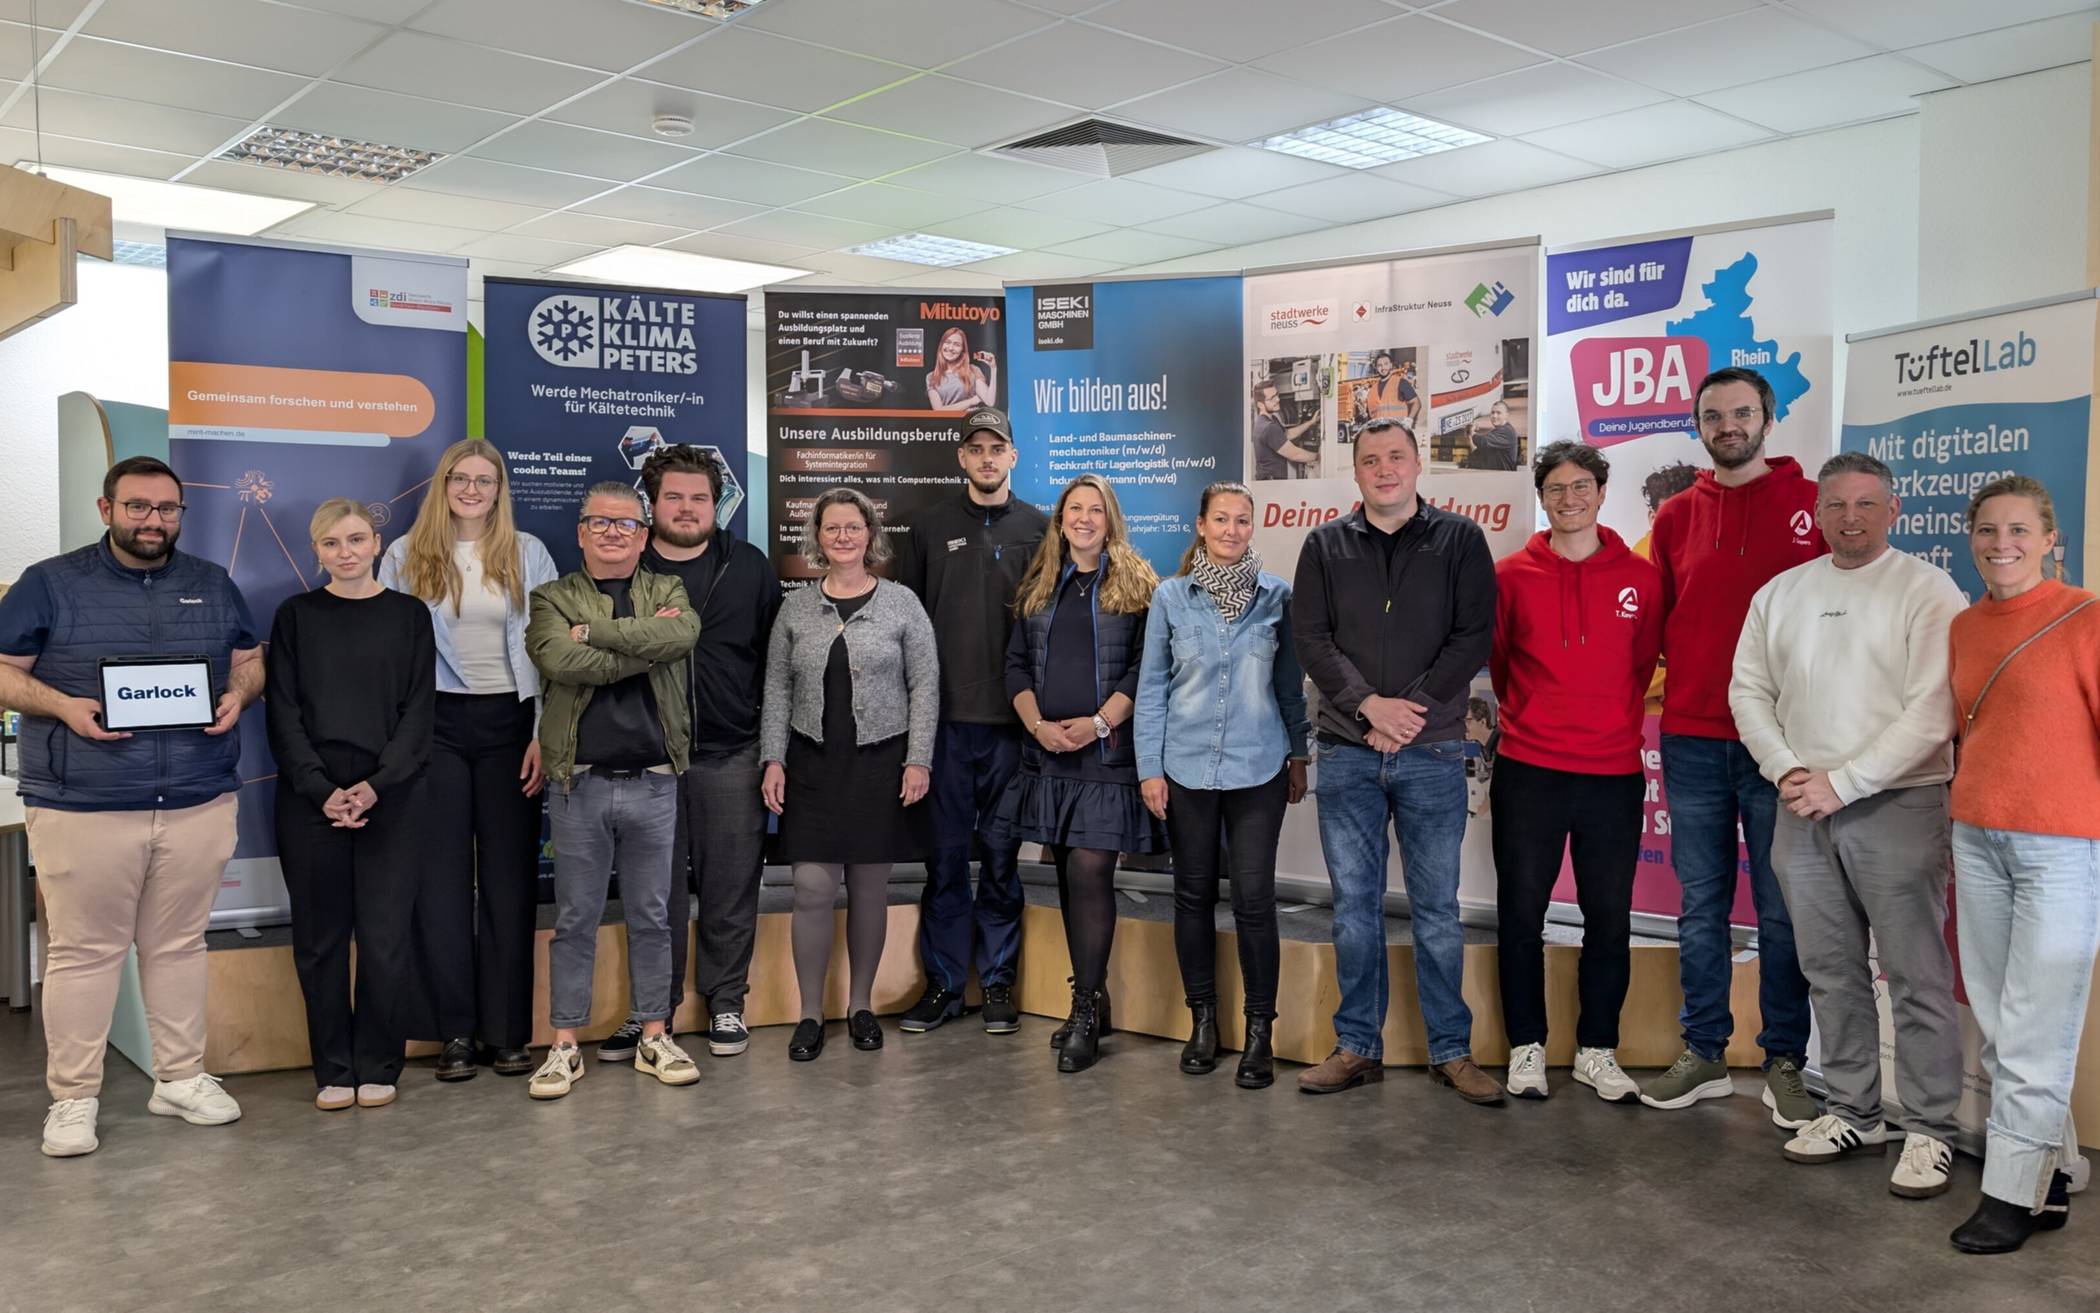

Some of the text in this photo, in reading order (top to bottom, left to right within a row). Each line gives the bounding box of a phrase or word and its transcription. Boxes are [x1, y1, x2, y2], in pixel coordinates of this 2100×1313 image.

[1566, 262, 1664, 290] Wir sind für
[390, 292, 406, 302] zdi
[1038, 296, 1089, 310] ISEKI
[1566, 290, 1628, 312] dich da.
[604, 294, 695, 325] KÄLTE
[920, 302, 1000, 324] Mitutoyo
[1271, 304, 1328, 321] stadtwerke
[1375, 300, 1452, 314] InfraStruktur Neuss
[778, 311, 888, 322] Du willst einen spannenden
[1038, 310, 1089, 320] MASCHINEN
[778, 324, 848, 334] Ausbildungsplatz
[1038, 320, 1064, 330] GMBH
[1271, 319, 1298, 330] neuss
[604, 324, 696, 350] KLIMA
[803, 337, 824, 345] Beruf
[826, 337, 840, 346] mit
[842, 338, 878, 346] Zukunft?
[604, 348, 698, 374] PETERS
[1732, 349, 1770, 367] Rhein
[1895, 330, 2036, 384] TüftelLab
[1592, 344, 1692, 406] JBA
[187, 390, 418, 412] Gemeinsam forschen und verstehen
[531, 384, 704, 405] Werde Mechatroniker/-in
[1034, 374, 1168, 414] Wir bilden aus!
[565, 401, 676, 418] für Kältetechnik
[1600, 416, 1696, 432] Deine Jugendberufs
[780, 427, 960, 444] Unsere Ausbildungsberufe
[1050, 432, 1176, 443] Land- und Baumaschinen-
[1050, 444, 1166, 457] mechatroniker (m/w/d)
[1869, 424, 2028, 464] Mit digitalen
[508, 452, 592, 462] Werde Teil eines
[866, 452, 876, 460] für
[1050, 456, 1216, 471] Fachkraft für Lagerlogistik (m/w/d)
[513, 466, 586, 476] coolen Teams!
[806, 460, 868, 470] Systemintegration
[780, 474, 796, 482] Dich
[798, 475, 842, 483] interessiert
[844, 476, 864, 484] alles,
[883, 476, 896, 484] mit
[898, 476, 961, 486] Computertechnik
[1138, 473, 1176, 485] (m/w/d)
[1122, 514, 1180, 522] ungsvergütung
[1264, 502, 1338, 528] Deine
[780, 580, 808, 588] Technik
[117, 684, 196, 700] Garlock
